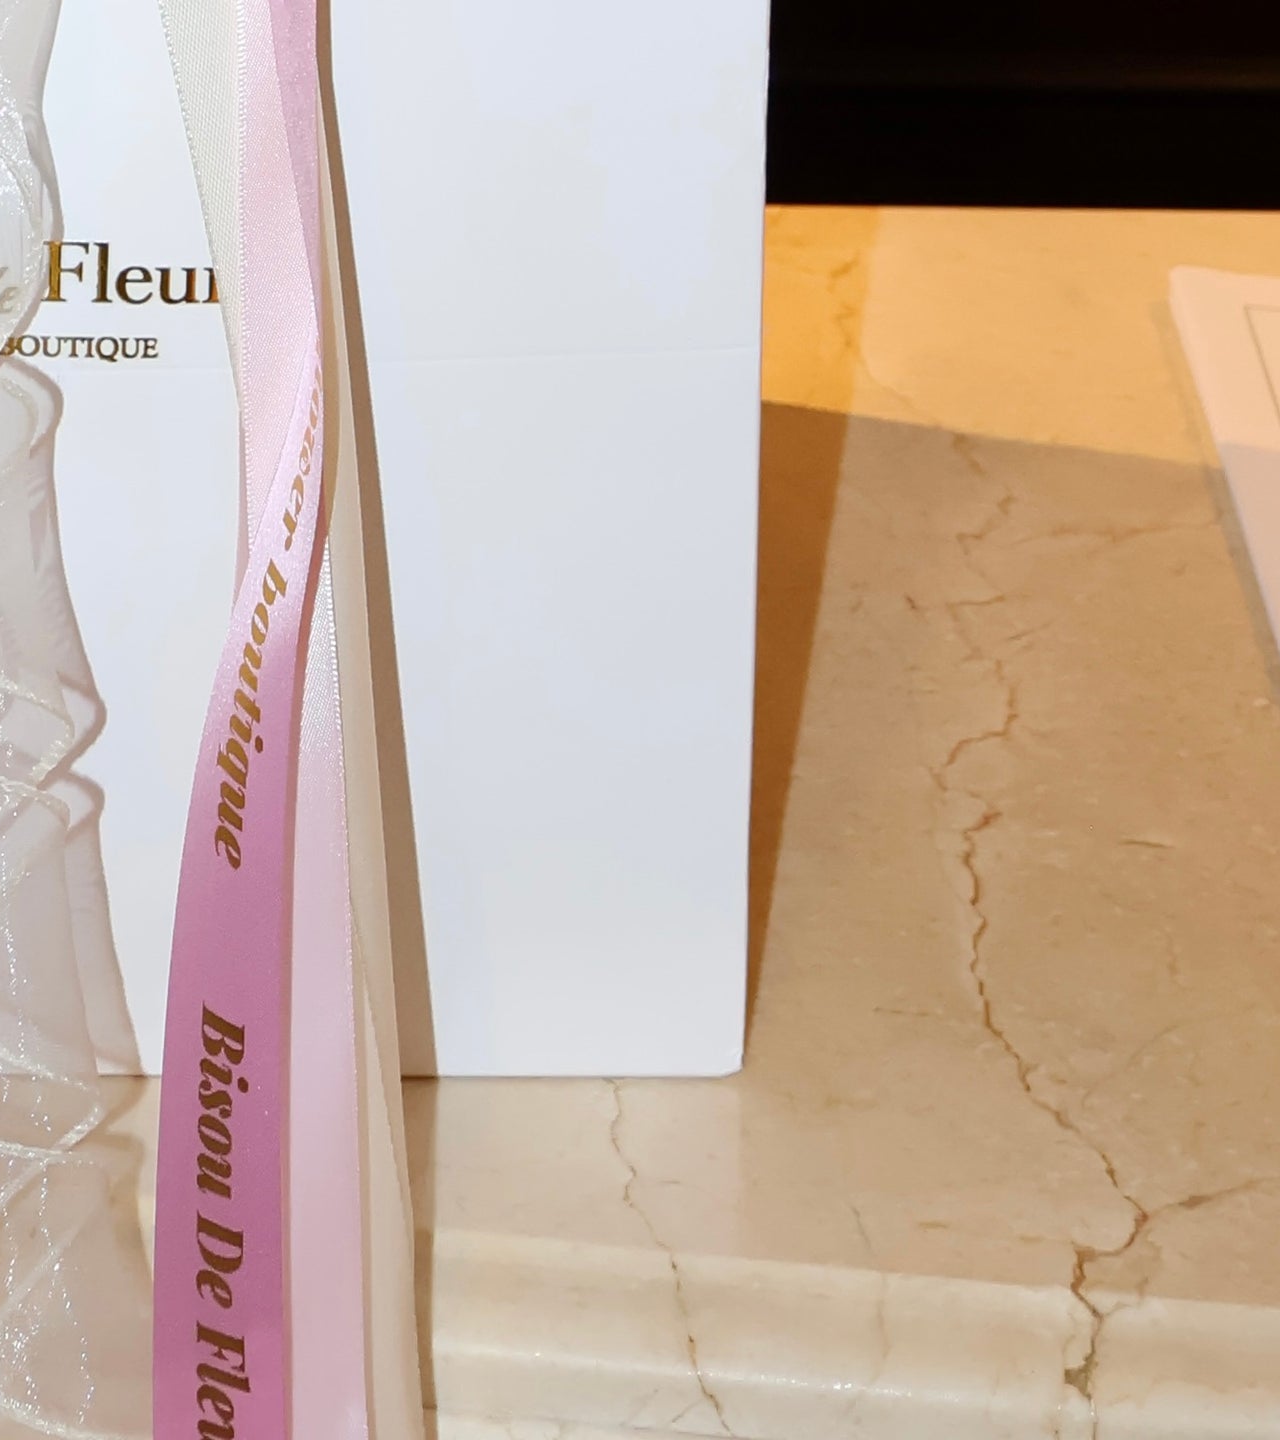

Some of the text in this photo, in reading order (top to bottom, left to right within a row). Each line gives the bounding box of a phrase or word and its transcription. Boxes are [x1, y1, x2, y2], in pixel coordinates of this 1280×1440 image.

[215, 557, 289, 870] boutique
[197, 1000, 249, 1200] Bisou
[196, 1209, 245, 1309] De
